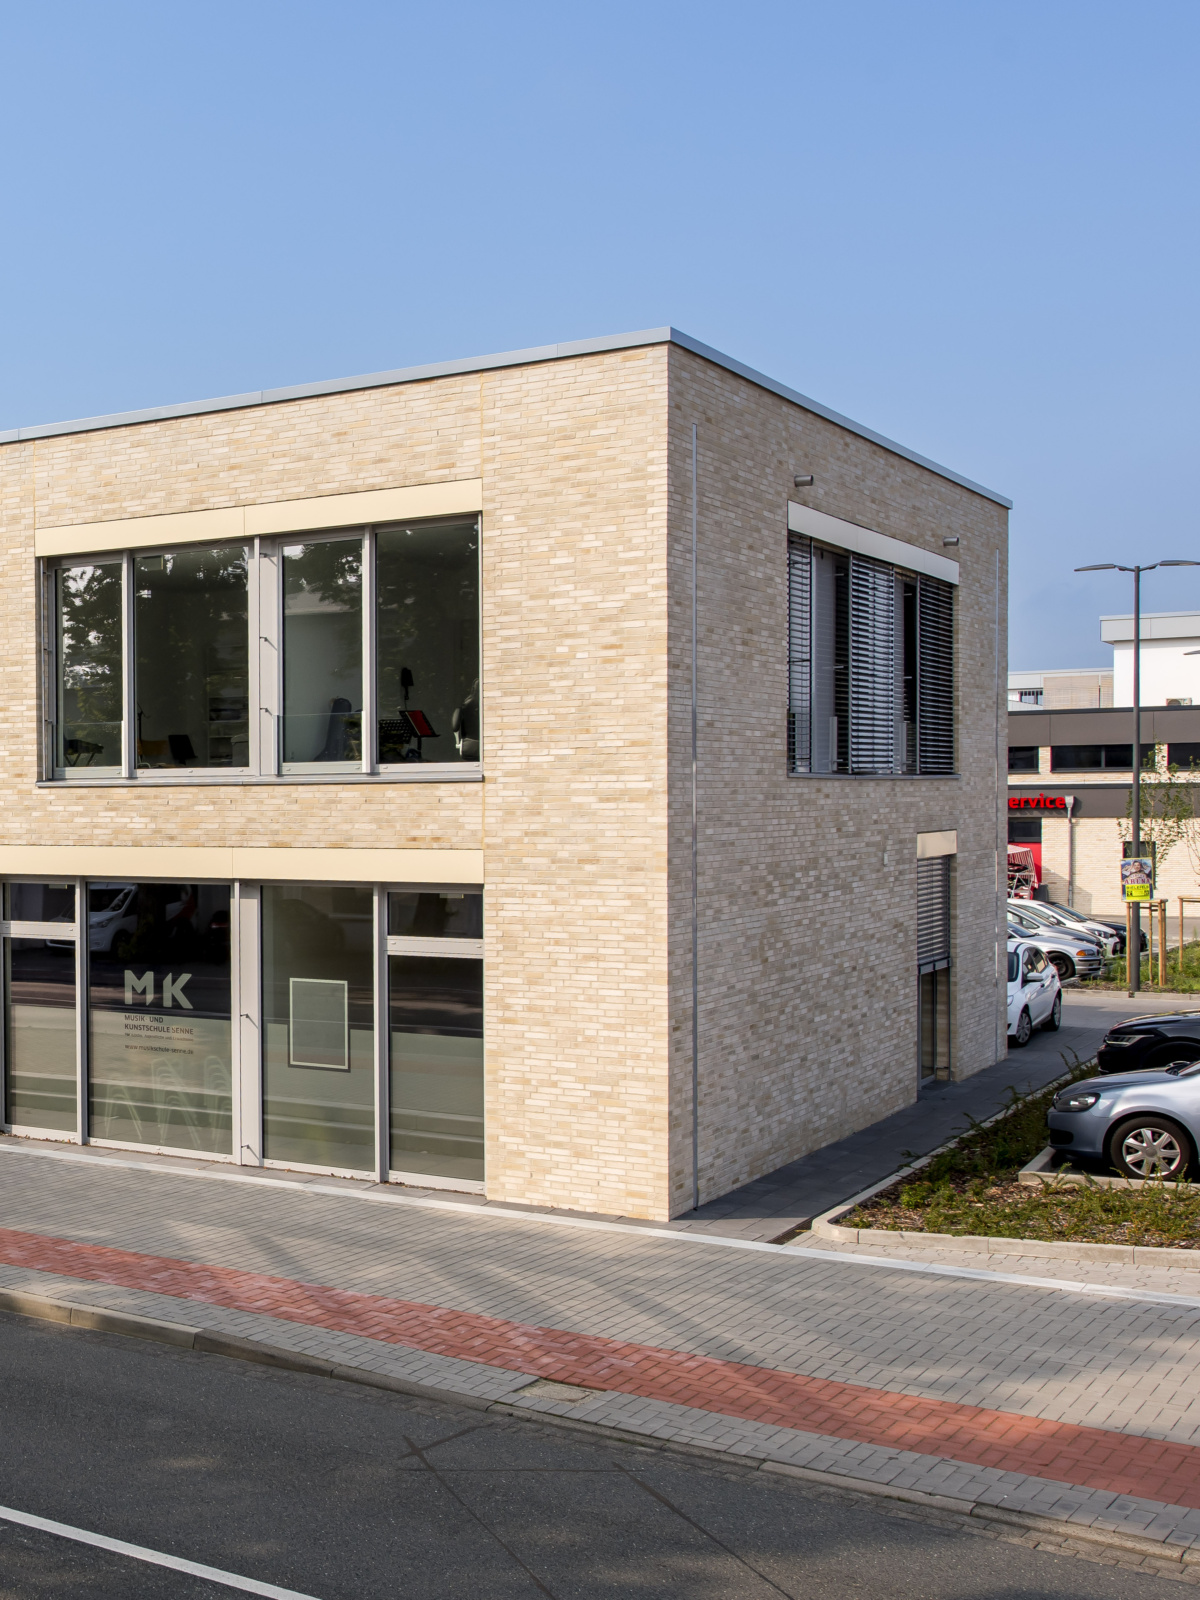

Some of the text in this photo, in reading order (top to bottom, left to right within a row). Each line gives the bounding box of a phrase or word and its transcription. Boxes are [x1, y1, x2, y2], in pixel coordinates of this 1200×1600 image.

[1008, 793, 1066, 809] ervice
[124, 969, 194, 1009] MK
[149, 1016, 164, 1024] UND
[124, 1023, 194, 1035] KUNSTSCHULE SENNE
